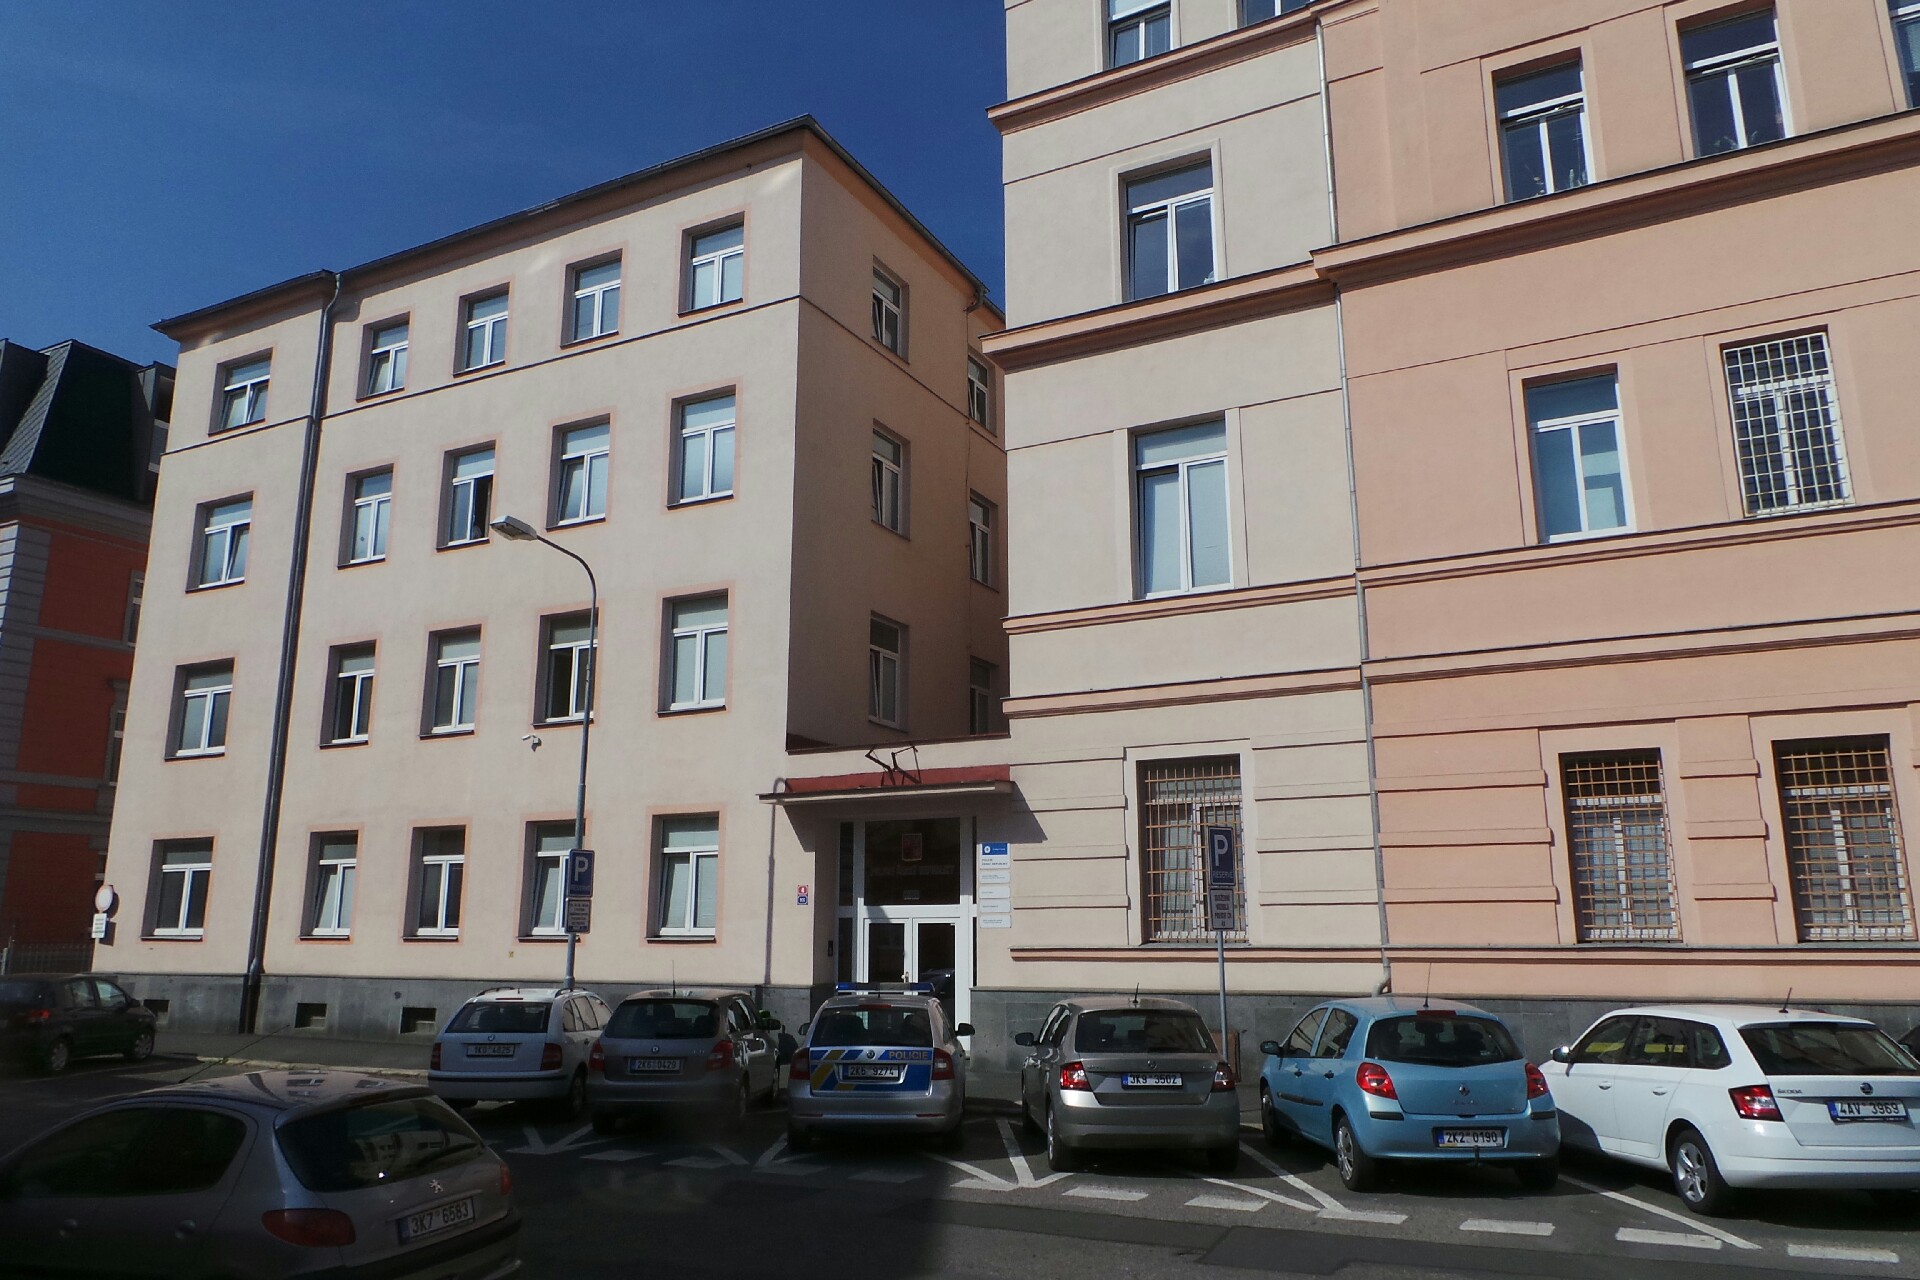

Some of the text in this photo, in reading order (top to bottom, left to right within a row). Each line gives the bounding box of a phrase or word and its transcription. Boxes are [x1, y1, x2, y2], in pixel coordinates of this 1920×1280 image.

[1214, 834, 1229, 867] P
[574, 856, 589, 882] P
[889, 1051, 929, 1059] POLICIE
[1130, 1074, 1148, 1084] 3K9
[1840, 1102, 1900, 1115] 4AV 3969
[1446, 1131, 1498, 1143] 2K2 0190
[411, 1202, 469, 1234] 3K7 6583
